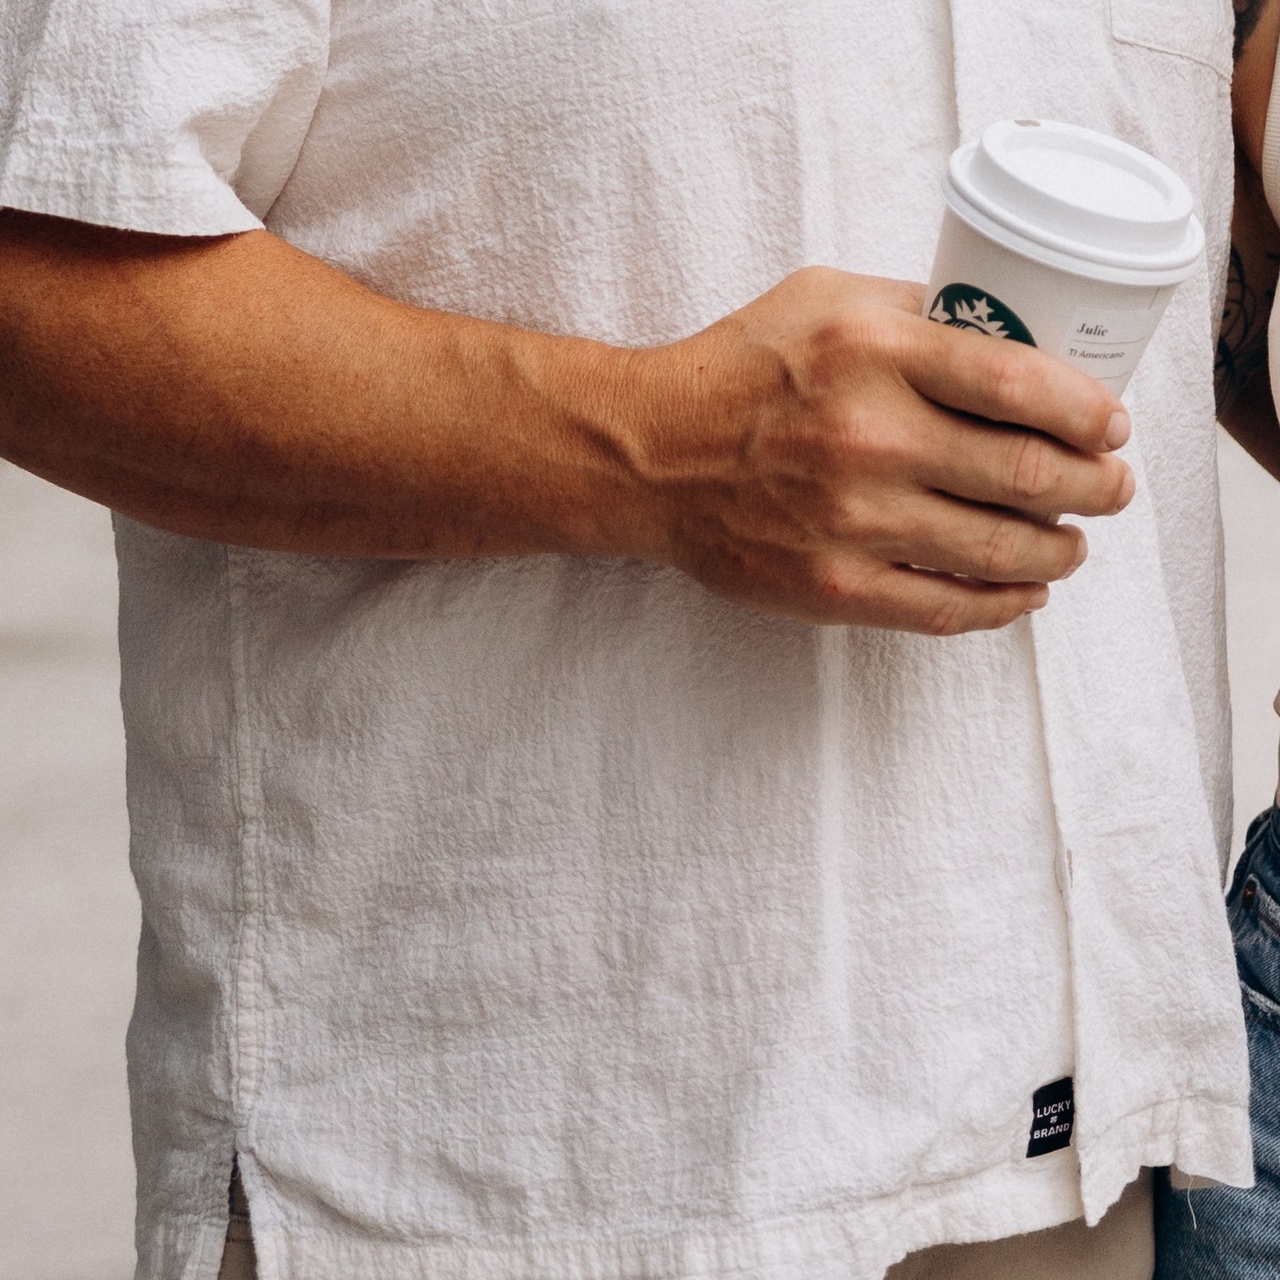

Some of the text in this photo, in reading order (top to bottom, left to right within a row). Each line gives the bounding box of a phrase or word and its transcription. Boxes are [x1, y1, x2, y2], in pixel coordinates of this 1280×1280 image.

[1076, 322, 1108, 336] Julie
[1079, 350, 1125, 359] Americano
[1037, 1100, 1071, 1118] LUCKY
[1034, 1123, 1070, 1139] BRAND
